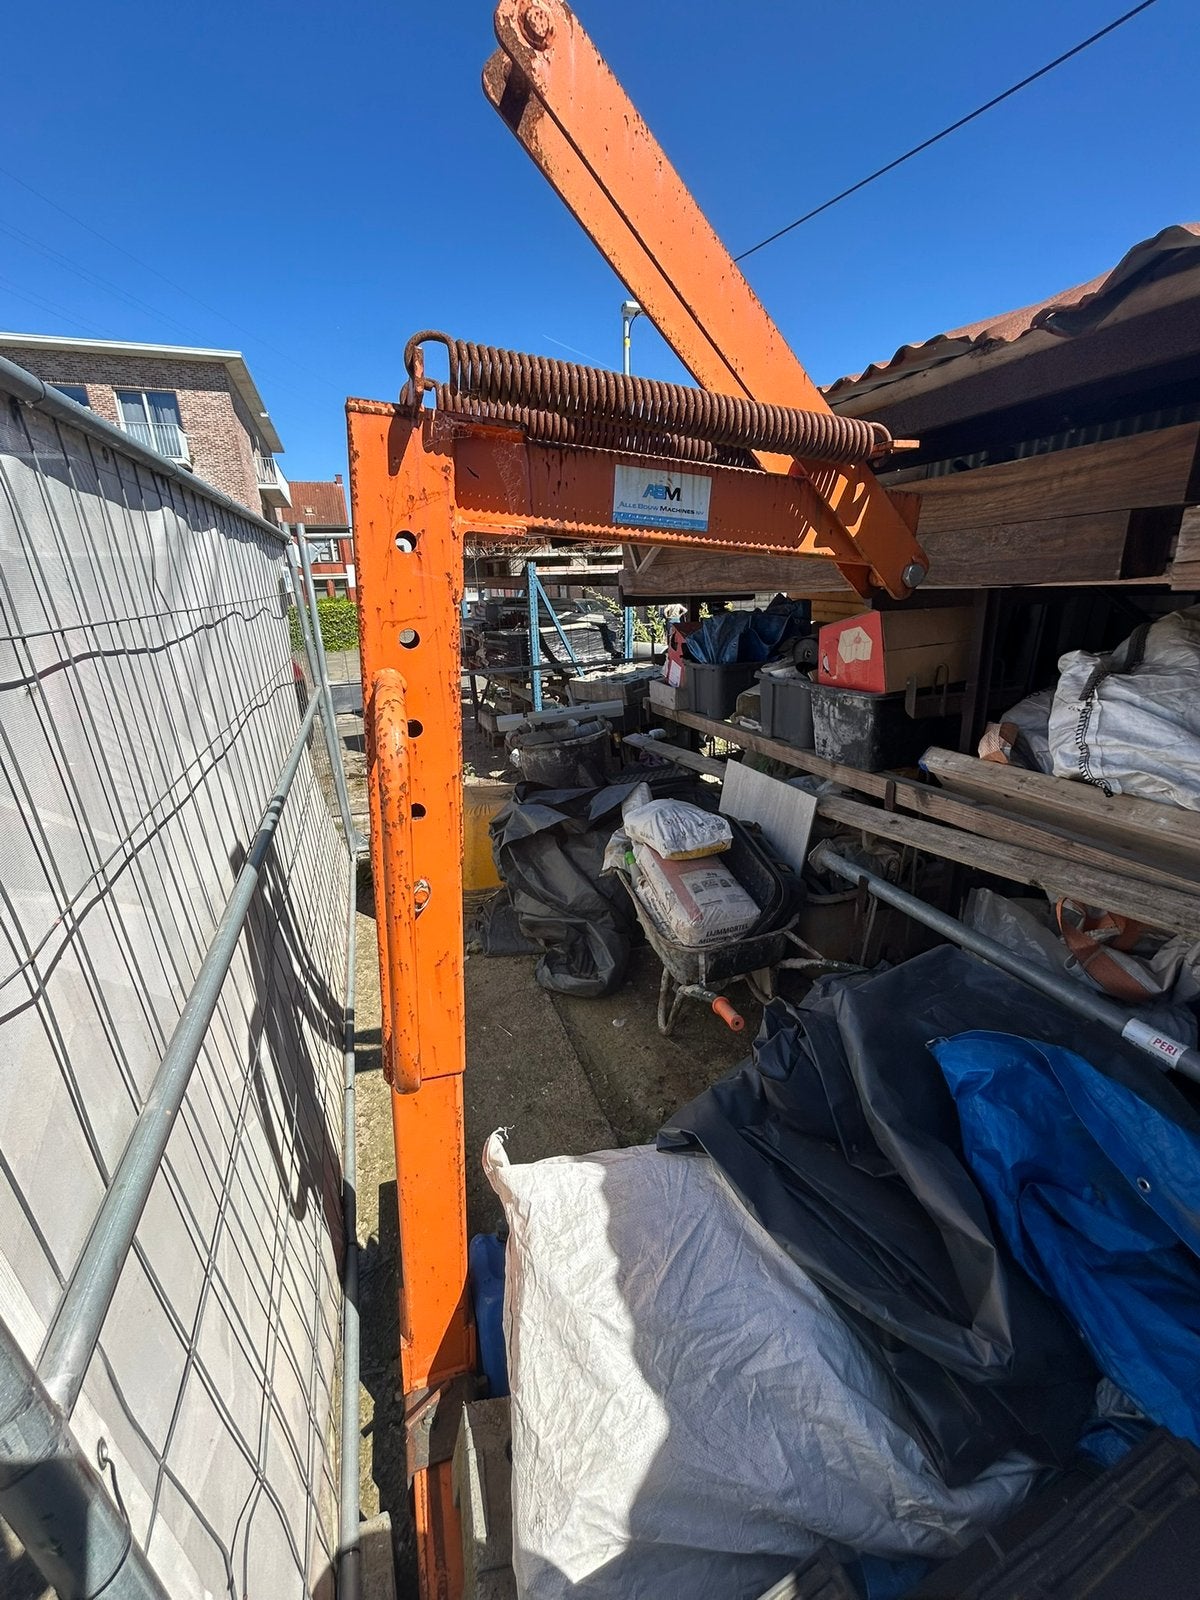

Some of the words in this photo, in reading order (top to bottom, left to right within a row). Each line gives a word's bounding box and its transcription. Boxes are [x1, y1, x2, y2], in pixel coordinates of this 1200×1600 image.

[642, 484, 681, 501] ABM
[660, 505, 695, 515] MACHINES
[1153, 1037, 1178, 1056] PERI
